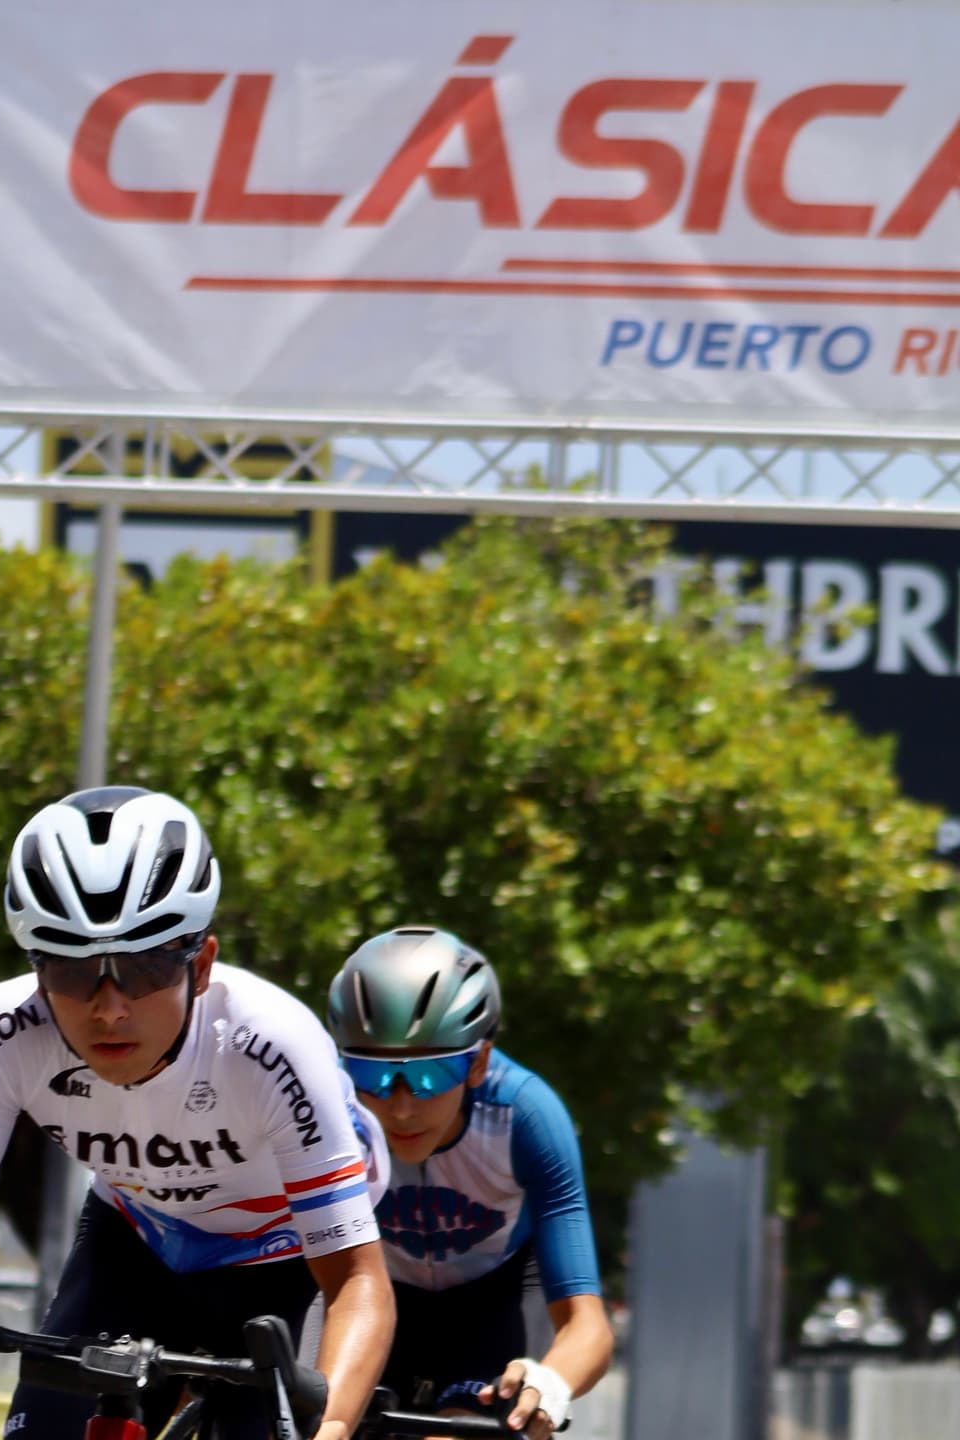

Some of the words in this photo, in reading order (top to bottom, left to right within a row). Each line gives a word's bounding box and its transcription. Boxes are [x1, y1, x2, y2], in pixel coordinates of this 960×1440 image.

[599, 319, 873, 376] PUERTO
[892, 327, 960, 377] RI
[244, 1034, 323, 1149] LUTRON
